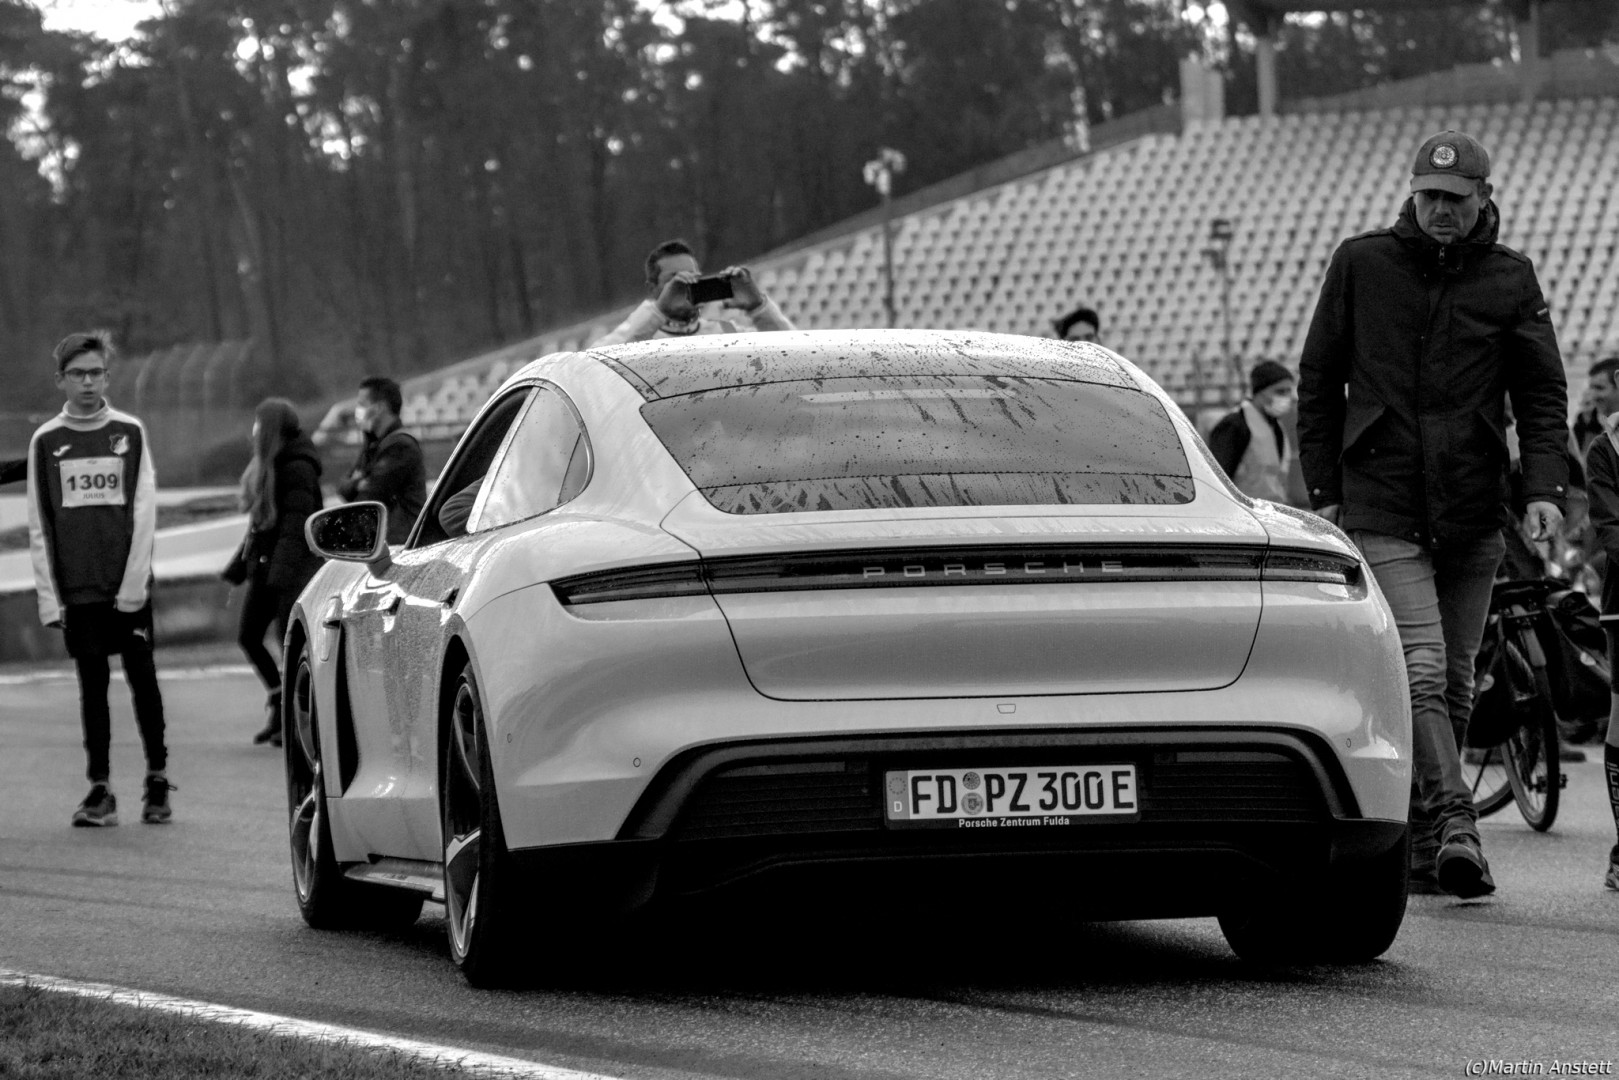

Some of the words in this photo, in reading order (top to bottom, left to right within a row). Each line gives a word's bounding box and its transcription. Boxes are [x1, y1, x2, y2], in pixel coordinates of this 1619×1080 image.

[66, 473, 118, 491] 1309
[863, 560, 1123, 578] PORSCHE
[911, 775, 957, 814] FD
[894, 801, 902, 812] D
[958, 818, 998, 828] Porsche
[1000, 817, 1040, 827] Zentrum
[1043, 816, 1070, 826] Fulda
